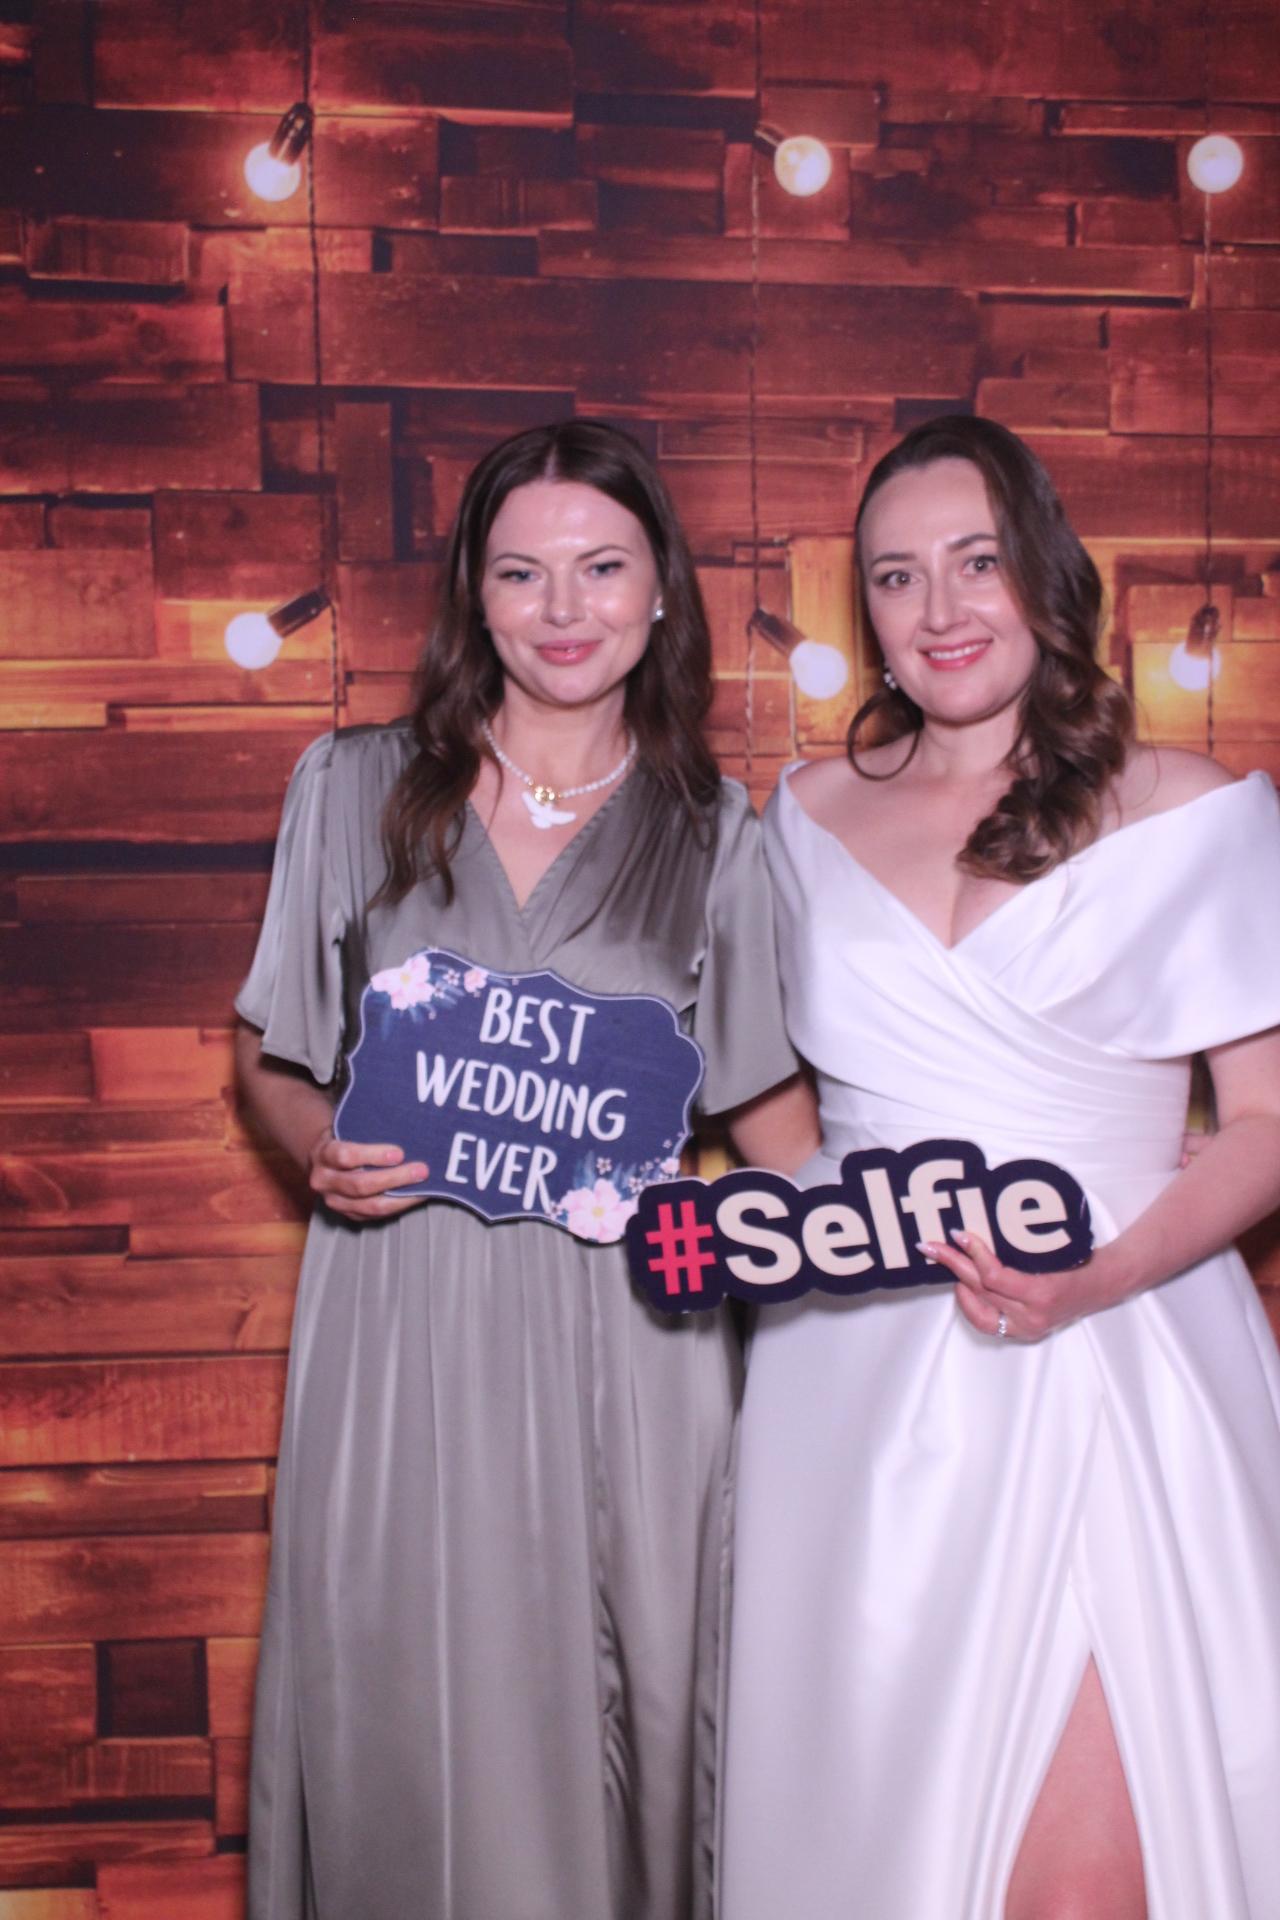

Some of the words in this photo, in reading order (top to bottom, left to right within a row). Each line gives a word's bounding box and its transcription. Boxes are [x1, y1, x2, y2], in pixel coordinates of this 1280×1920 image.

[479, 986, 596, 1066] BEST
[416, 1050, 628, 1142] WEDDING
[444, 1131, 558, 1213] EVER
[644, 1158, 1073, 1296] #Selfie
